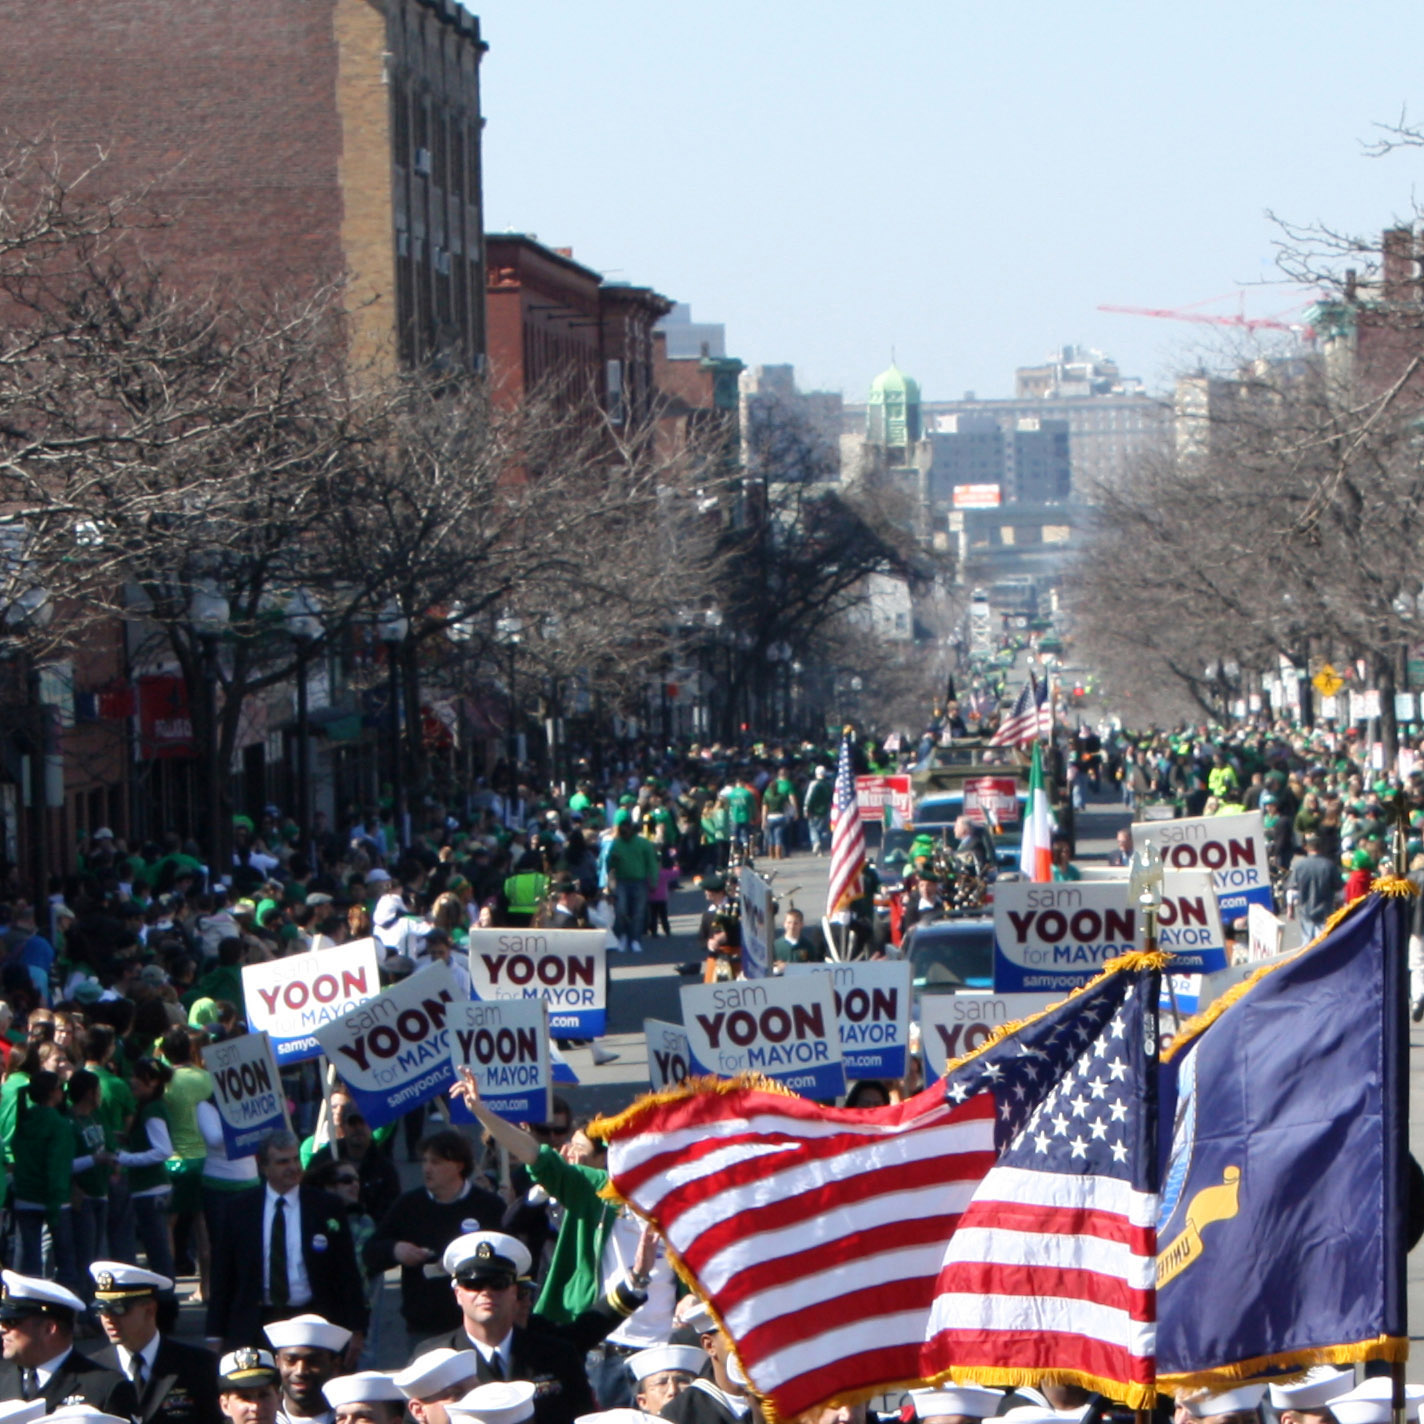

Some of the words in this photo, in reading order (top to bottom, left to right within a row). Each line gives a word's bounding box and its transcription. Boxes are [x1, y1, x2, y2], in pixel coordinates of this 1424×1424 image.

[1160, 823, 1207, 843] sam
[1027, 888, 1082, 908] sam
[1007, 908, 1135, 943] YOON
[1159, 928, 1212, 945] AYOR
[498, 935, 548, 952] sam
[1023, 946, 1055, 964] for
[481, 954, 595, 986] YOON
[257, 966, 368, 1015] YOON
[522, 988, 595, 1005] MAYOR
[713, 984, 768, 1010] sam
[345, 998, 399, 1036] sam
[465, 1006, 502, 1027] sam
[953, 1000, 1006, 1021] sam
[337, 988, 454, 1071] YOON
[696, 1002, 825, 1048] YOON
[456, 1027, 539, 1065] YOON
[718, 1050, 746, 1071] for
[747, 1040, 829, 1068] MAYOR
[214, 1059, 272, 1104] YOON
[373, 1065, 398, 1087] for
[487, 1065, 540, 1086] MAYOR
[241, 1094, 276, 1119] MAYOR
